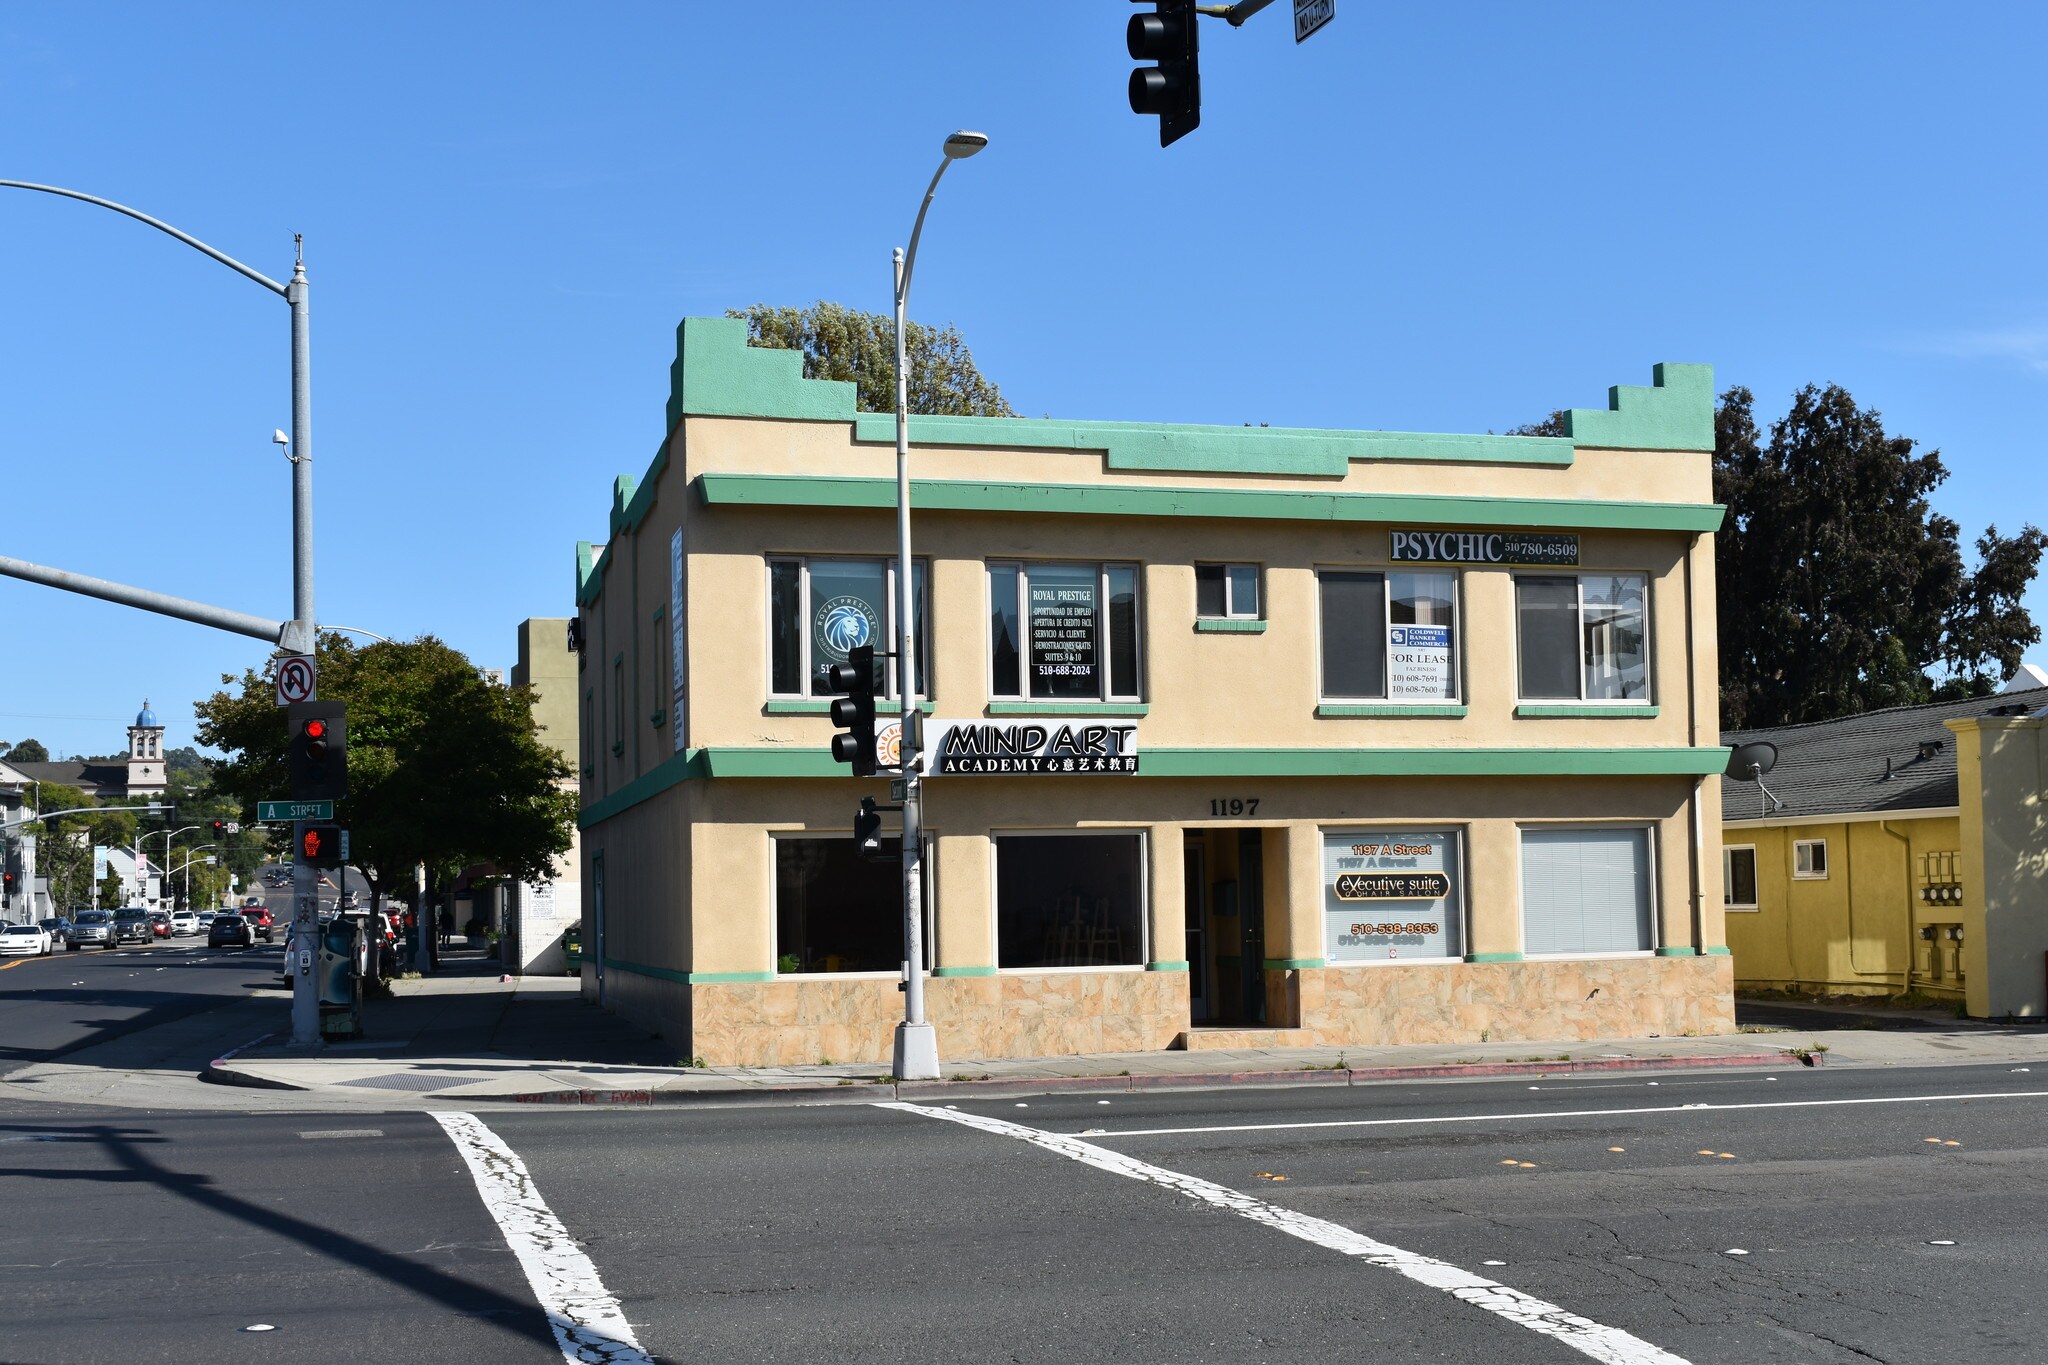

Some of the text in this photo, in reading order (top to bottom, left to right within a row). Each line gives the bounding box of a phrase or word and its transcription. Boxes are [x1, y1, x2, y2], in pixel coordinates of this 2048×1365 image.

[1300, 12, 1308, 33] NO
[1391, 532, 1578, 562] PSYCHIC 510 780-6509
[1033, 590, 1091, 601] ROYAL PRESTIGE
[817, 598, 876, 626] ROYAL PRESTIGE
[1066, 607, 1073, 616] DE
[1074, 607, 1091, 616] EMPLEO
[1056, 618, 1062, 627] DE
[1058, 629, 1064, 638] AL
[1066, 629, 1086, 639] CLIENTE
[1075, 653, 1082, 661] 10
[1417, 655, 1454, 664] LEASE
[1039, 665, 1091, 675] 510-688-2024
[1406, 674, 1438, 683] 608-7691
[1405, 686, 1438, 694] 608-7600
[946, 724, 1138, 756] MIND ART
[944, 758, 1041, 772] ACADEMY
[1047, 757, 1137, 771] 心意艺术教育
[267, 804, 322, 818] A STREET
[1210, 798, 1260, 816] 1197
[1352, 844, 1432, 856] 1197 A Street
[1409, 876, 1440, 891] suite
[1351, 923, 1439, 935] 510-538-8353
